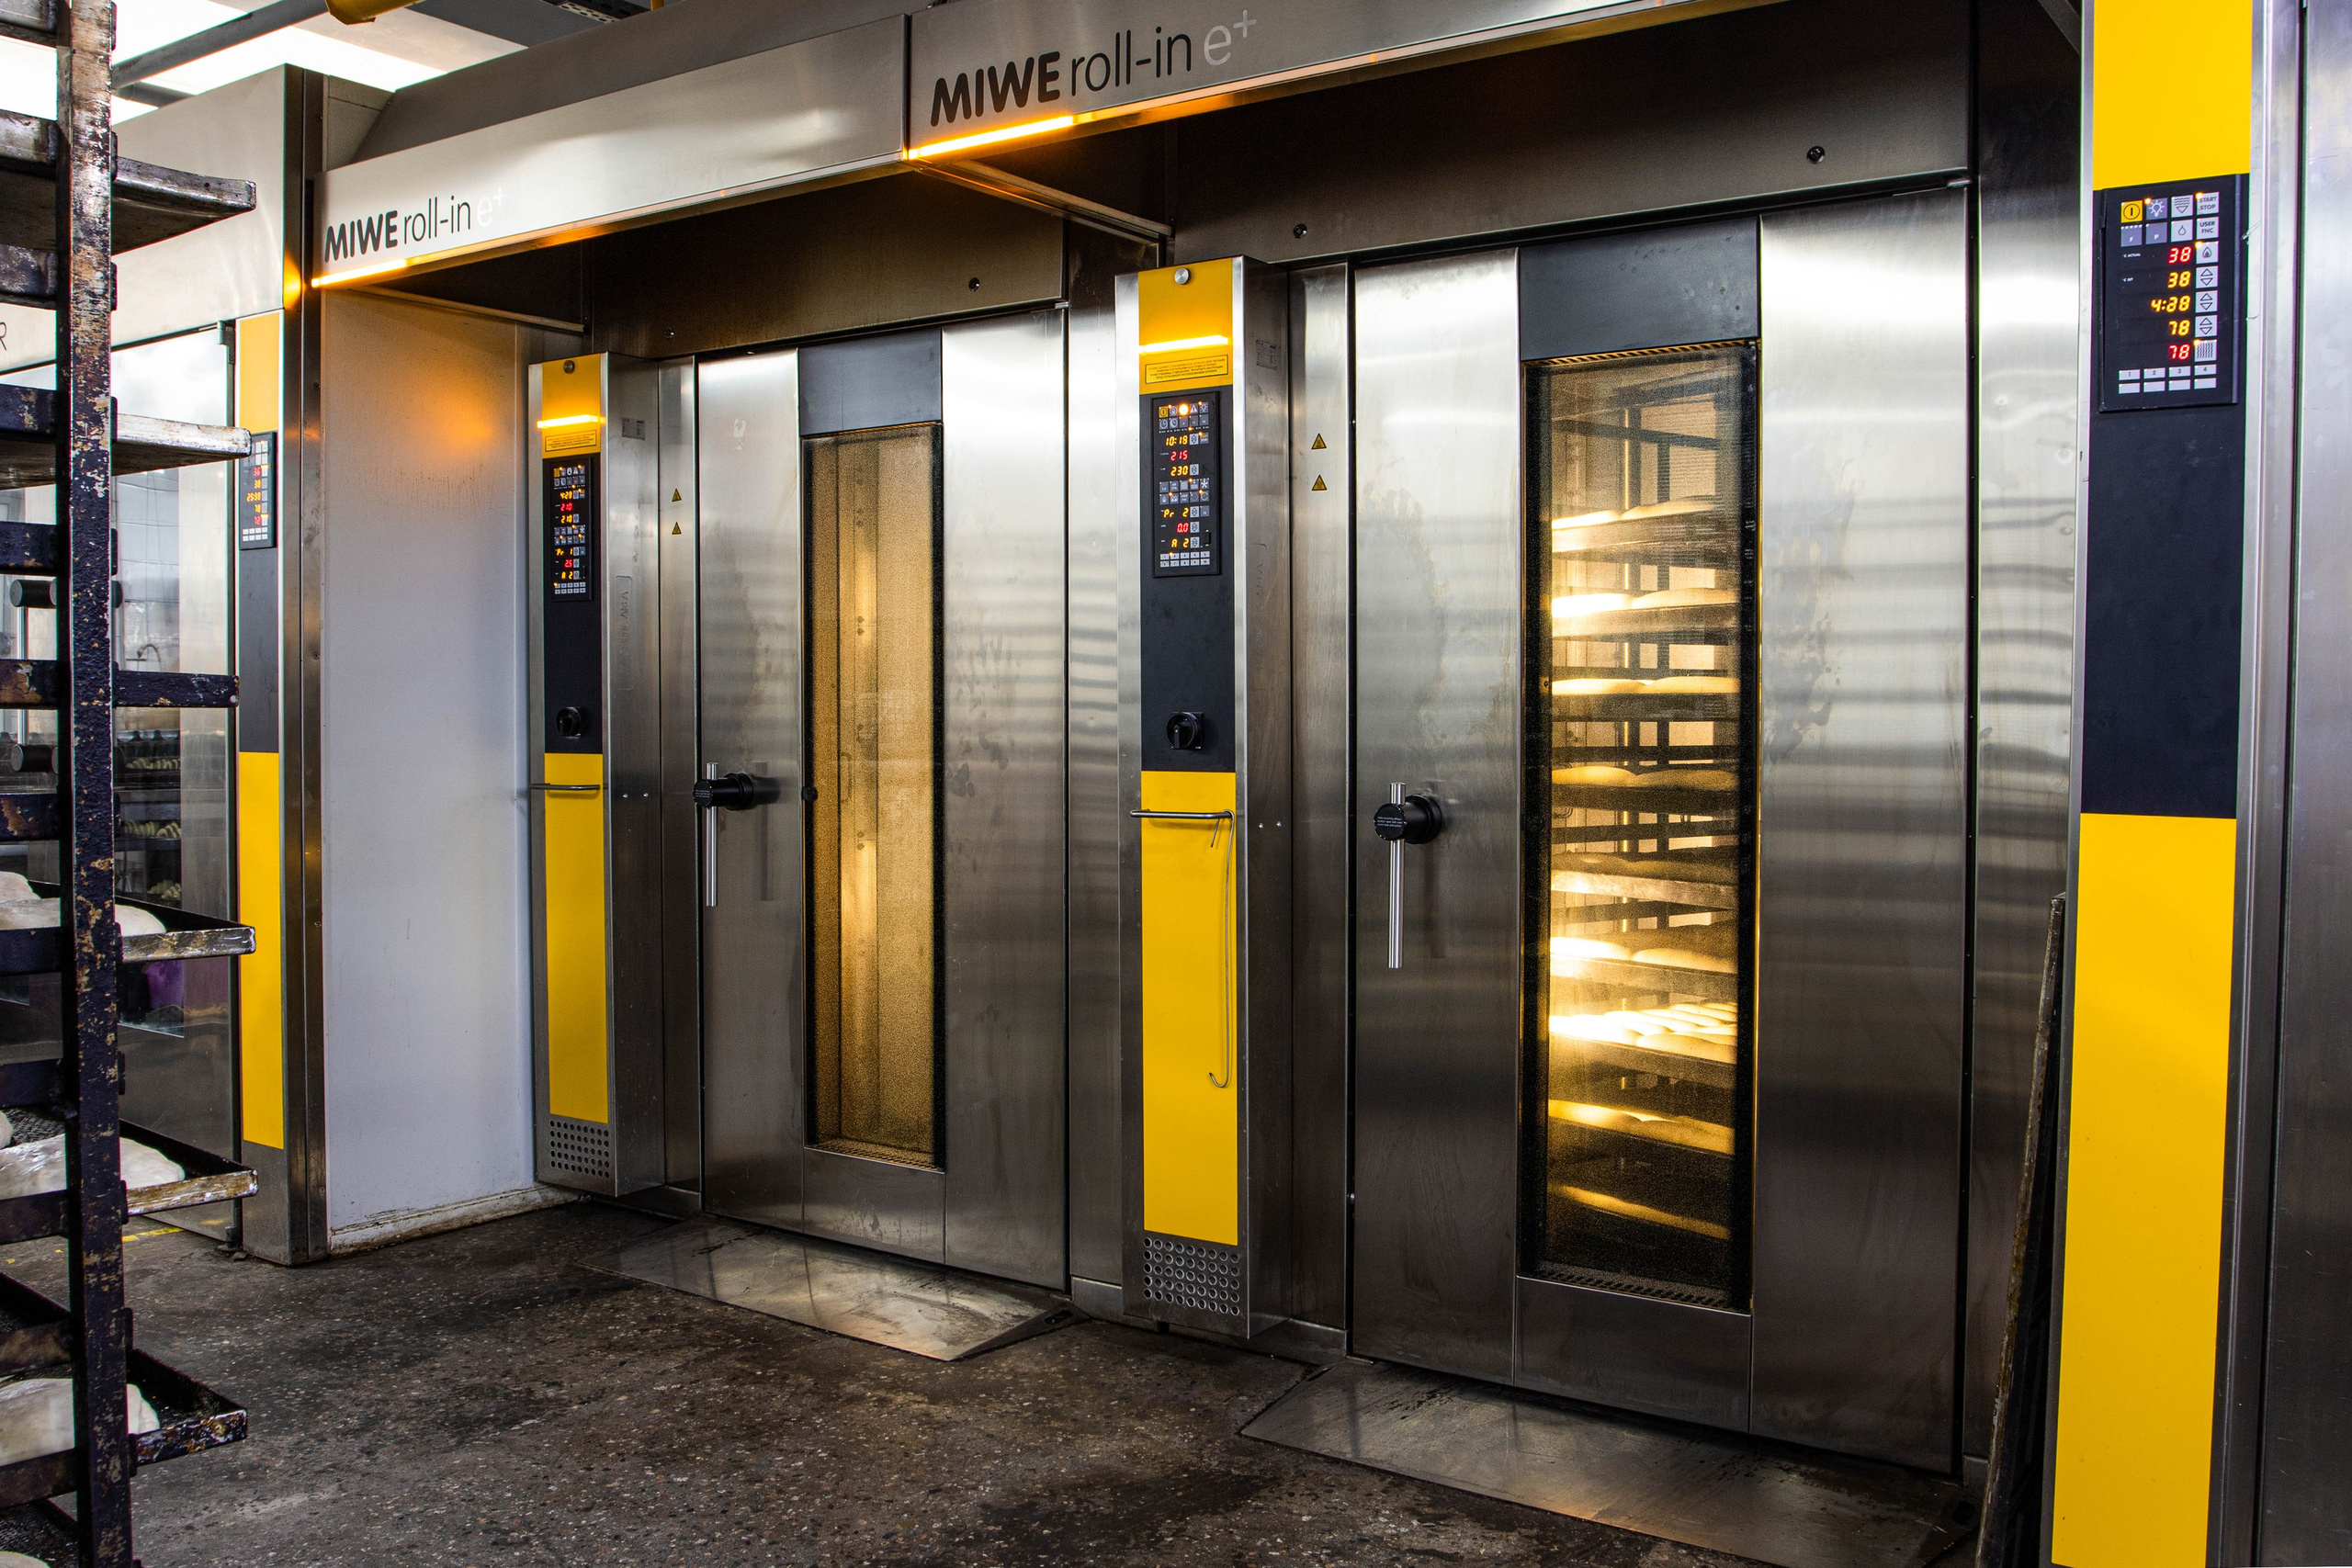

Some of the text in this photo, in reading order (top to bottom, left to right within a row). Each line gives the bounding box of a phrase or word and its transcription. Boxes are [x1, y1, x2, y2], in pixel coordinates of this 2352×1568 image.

[930, 51, 1060, 127] MIWE
[1071, 26, 1192, 97] roll-in
[324, 209, 398, 263] MIWE
[404, 195, 471, 244] roll-in
[2168, 246, 2191, 264] 38
[2167, 271, 2191, 288] 38
[2168, 320, 2190, 336] 78
[2168, 344, 2190, 360] 78
[1165, 434, 1188, 446] 10:18
[1170, 450, 1189, 461] 215
[1170, 466, 1189, 477] 230
[1182, 507, 1189, 518] 2
[1171, 537, 1189, 548] A 2
